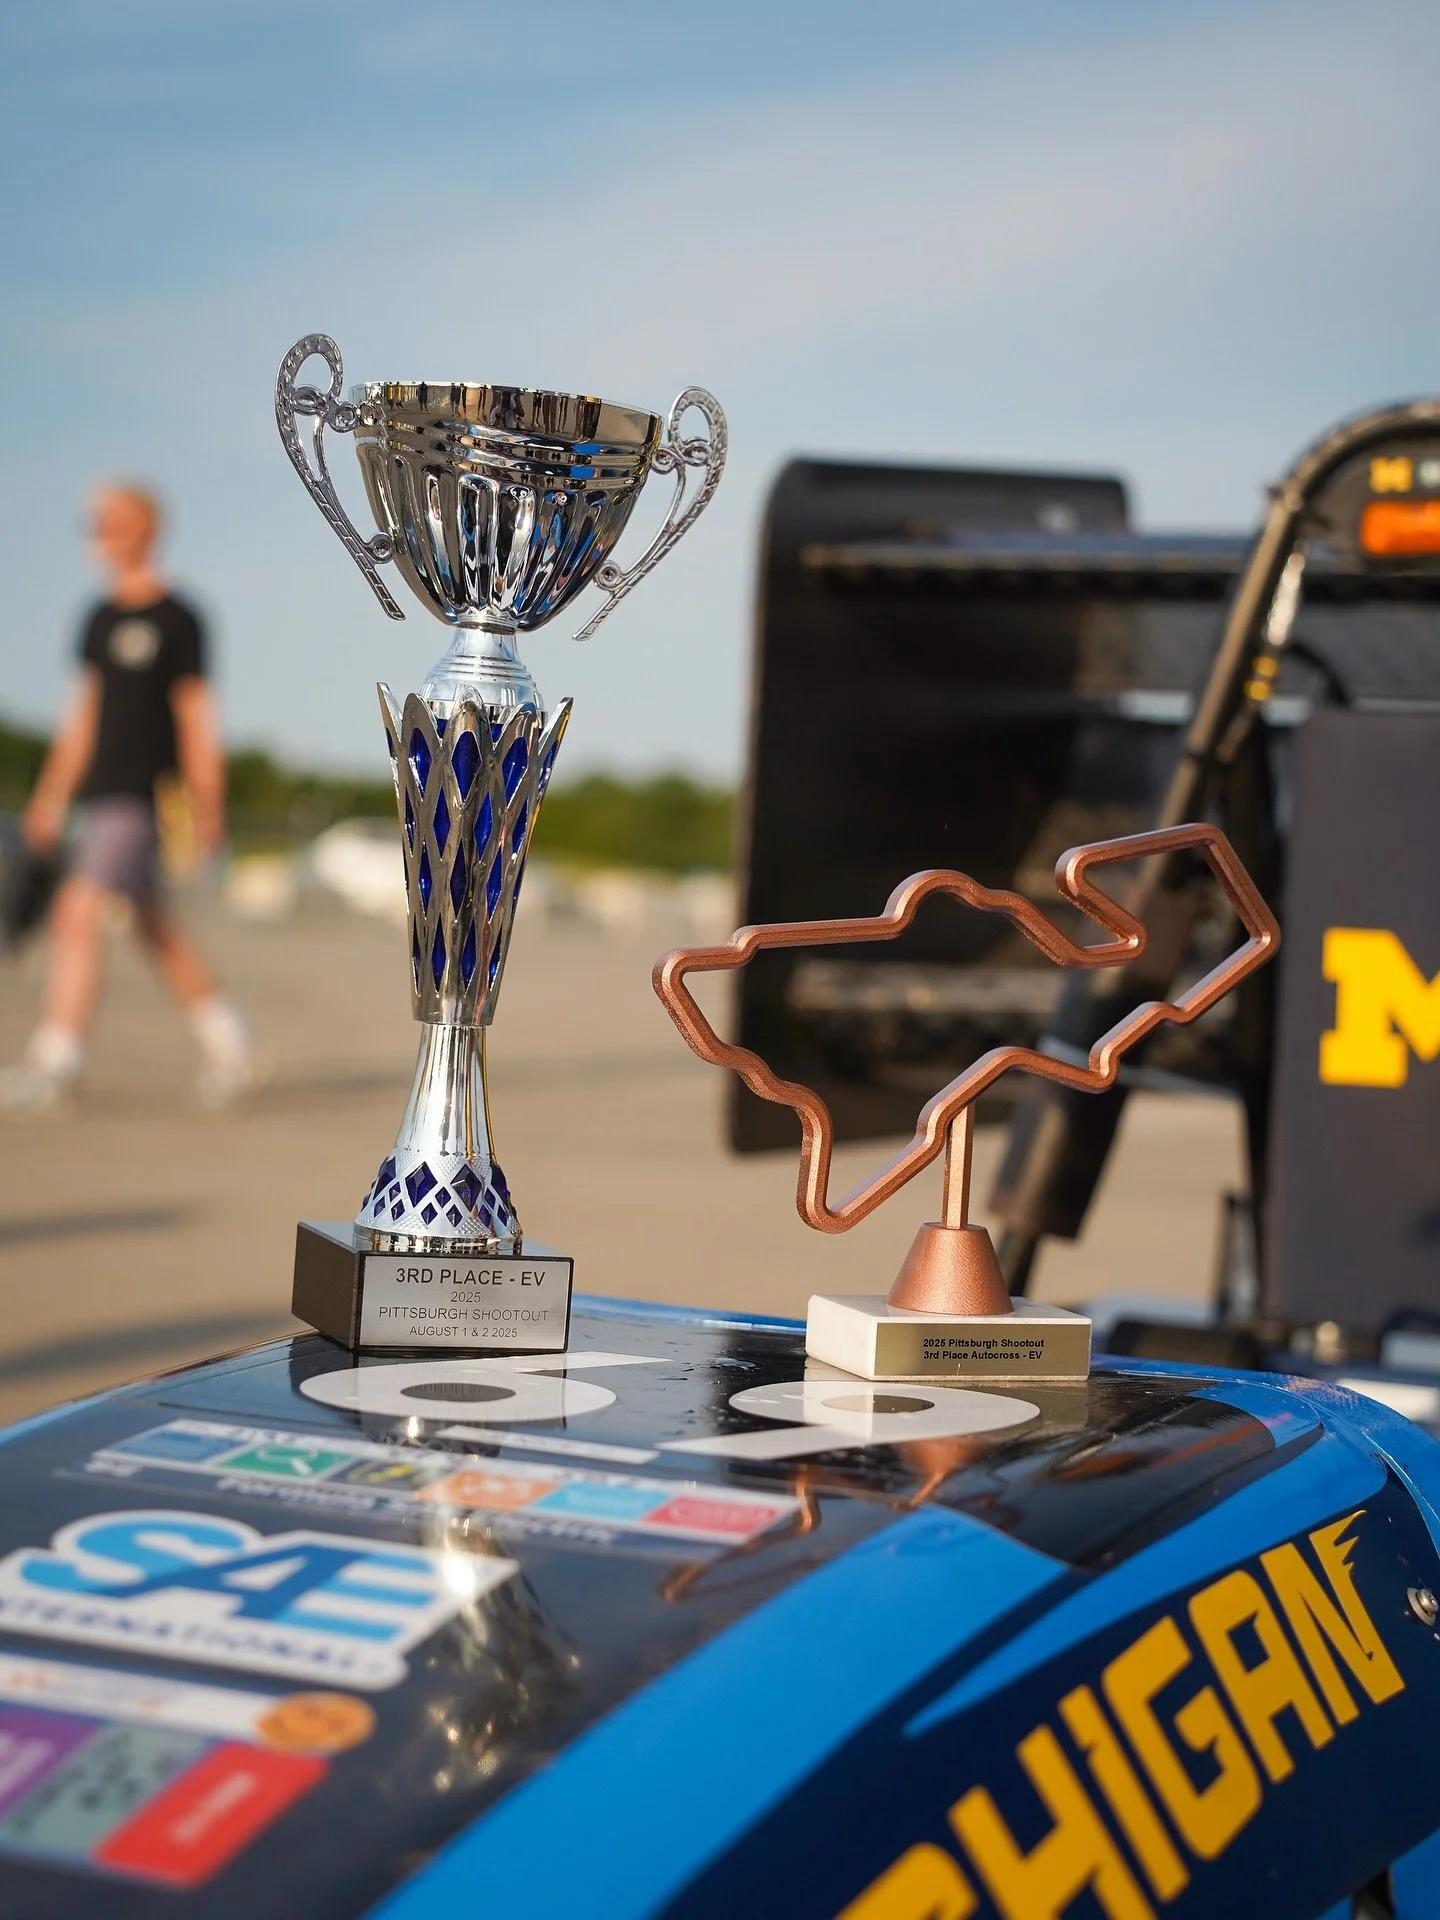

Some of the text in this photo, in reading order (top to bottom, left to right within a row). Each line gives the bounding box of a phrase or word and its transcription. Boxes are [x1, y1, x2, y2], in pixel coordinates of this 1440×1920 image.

[1319, 927, 1440, 1088] M
[396, 1267, 434, 1284] 3RD
[440, 1268, 503, 1287] PLACE
[520, 1271, 547, 1287] EV
[450, 1291, 481, 1303] 2025
[379, 1306, 550, 1322] PITTSBURGH SHOOTOUT
[409, 1326, 459, 1337] AUGUST
[471, 1326, 480, 1338] &
[482, 1326, 490, 1338] 2
[492, 1327, 518, 1338] 2025
[923, 1338, 1045, 1350] 2025 Pittsburgh Shootout
[923, 1350, 939, 1360] 3rd
[942, 1350, 969, 1360] Place
[971, 1350, 1020, 1360] Autocross
[1028, 1350, 1043, 1360] EV
[20, 1519, 438, 1642] SAE
